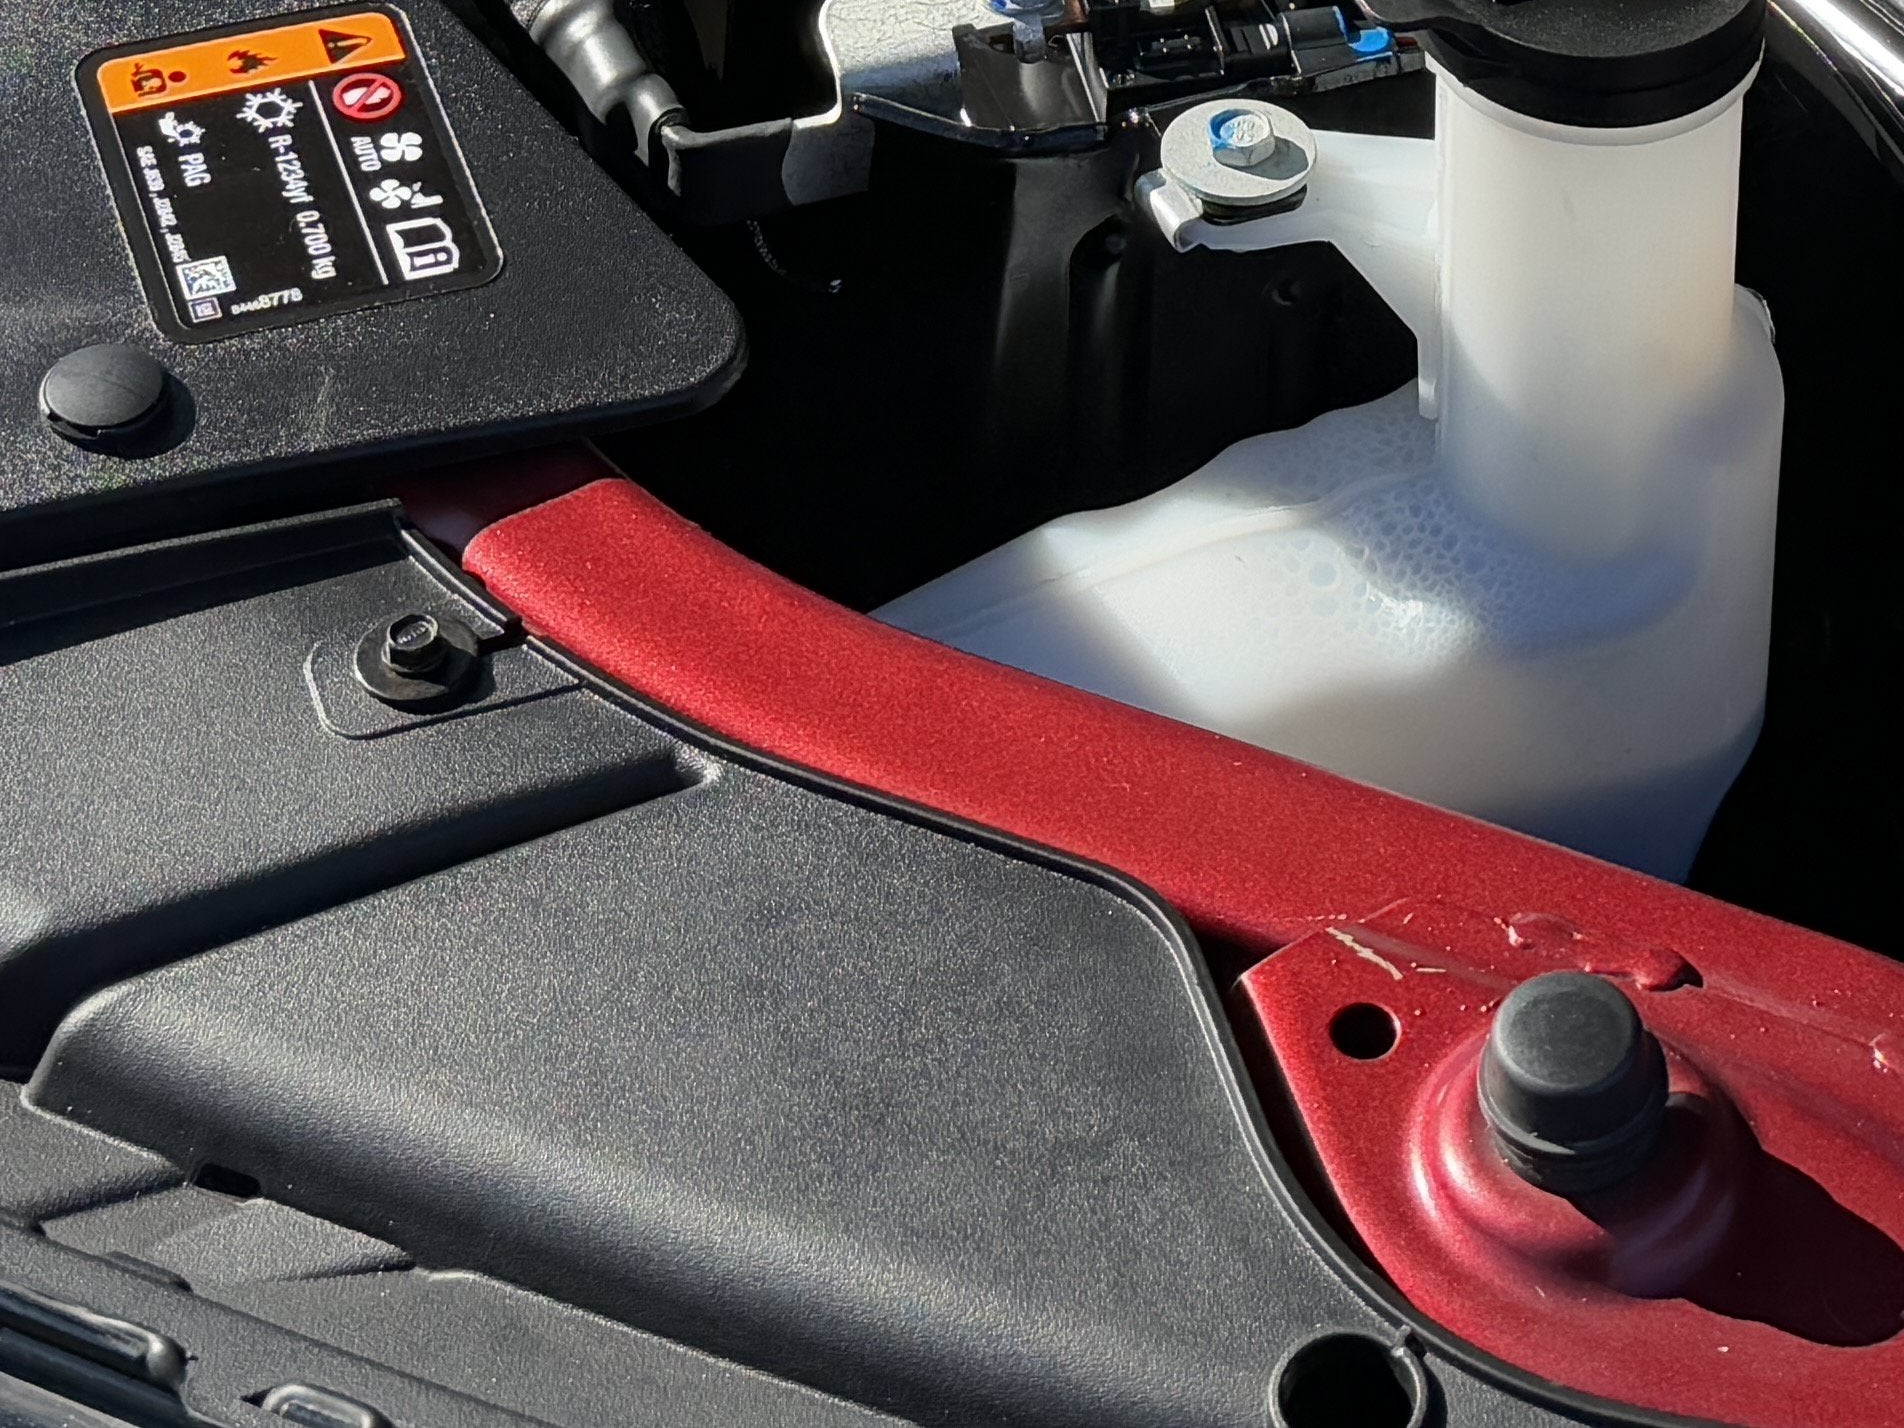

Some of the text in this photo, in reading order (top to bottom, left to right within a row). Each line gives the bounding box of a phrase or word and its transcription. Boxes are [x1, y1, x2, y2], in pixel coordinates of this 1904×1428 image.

[178, 152, 212, 187] PAG
[351, 136, 382, 171] AUTO
[268, 134, 337, 279] R-1234yf 0.700 kg
